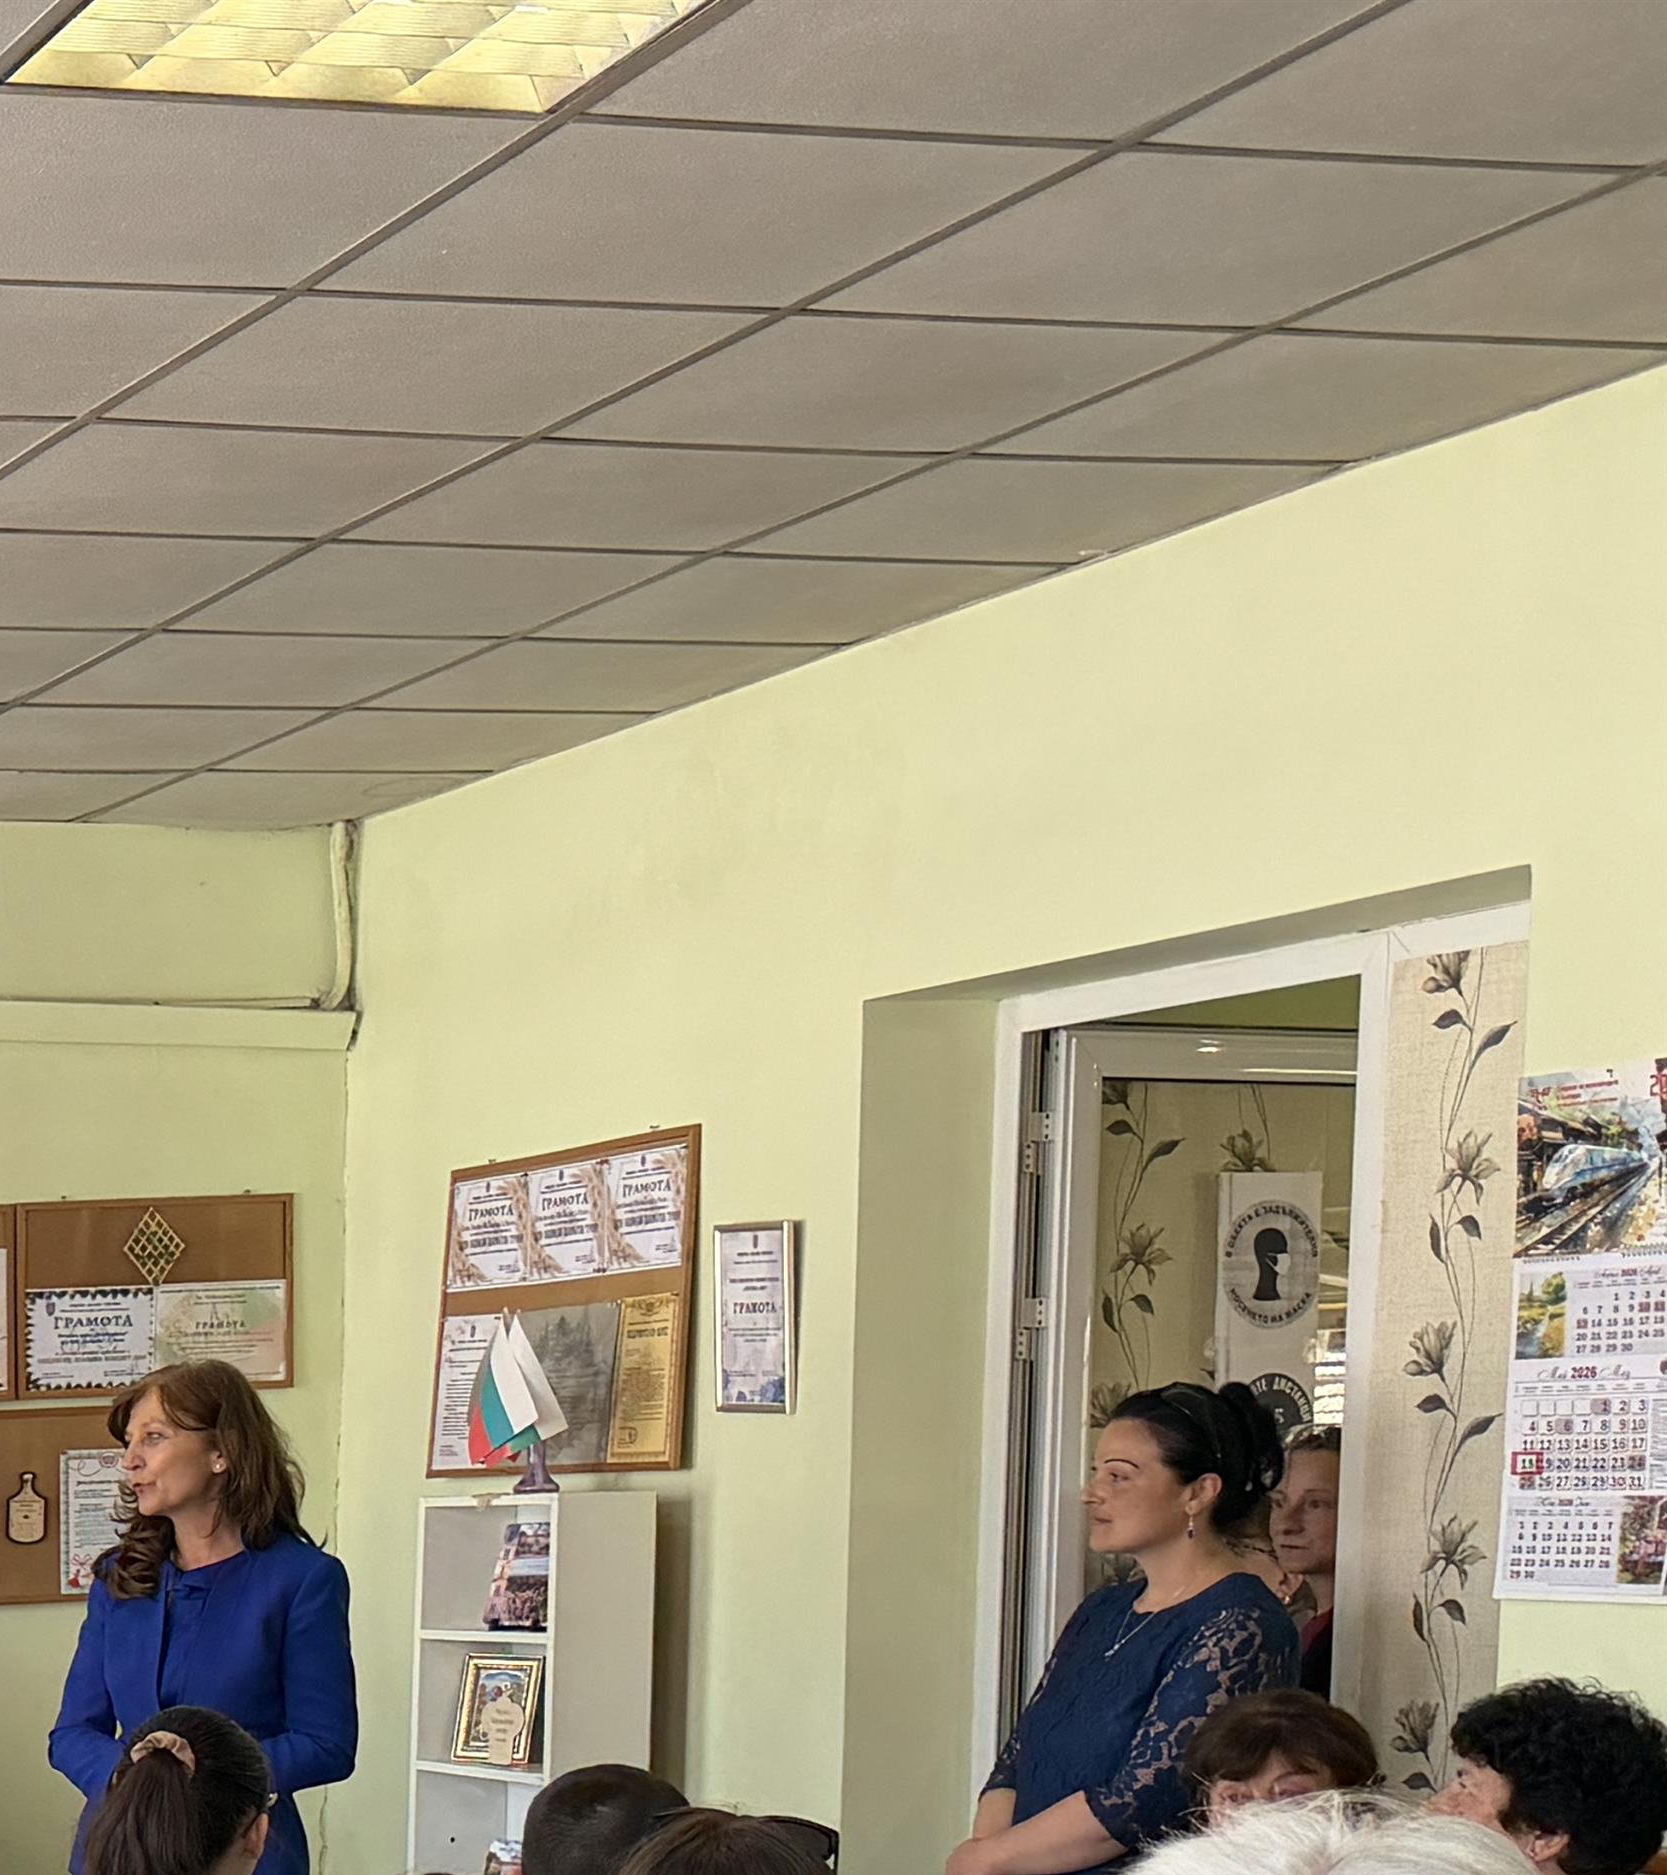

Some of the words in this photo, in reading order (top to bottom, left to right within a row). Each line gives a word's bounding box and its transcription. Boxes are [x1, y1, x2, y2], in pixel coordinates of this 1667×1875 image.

[622, 1178, 671, 1198] ГРАМОТА
[541, 1191, 589, 1211] ГРАМОТА
[468, 1204, 514, 1222] ГРАМОТА
[733, 1301, 778, 1314] ГРАМОТА
[53, 1314, 133, 1330] ГРАМОТА
[1570, 1366, 1597, 1379] 2026
[1619, 1400, 1627, 1412] 2
[1638, 1399, 1646, 1412] 3
[1529, 1421, 1536, 1432] 4
[1546, 1421, 1553, 1432] 5
[1582, 1420, 1589, 1431] 7
[1600, 1420, 1608, 1431] 8
[1619, 1419, 1627, 1431] 9
[1631, 1419, 1646, 1430] 10
[1523, 1440, 1535, 1451] 11
[1539, 1439, 1552, 1450] 12
[1557, 1439, 1571, 1450] 13
[1574, 1439, 1588, 1450] 14
[1593, 1438, 1607, 1450] 15
[1611, 1438, 1626, 1449] 16
[1631, 1437, 1645, 1449] 17
[1555, 1458, 1571, 1470] 20
[1573, 1457, 1587, 1469] 21
[1591, 1457, 1607, 1470] 22
[1611, 1457, 1626, 1469] 23
[1556, 1476, 1569, 1487] 27
[1610, 1476, 1626, 1487] 30
[1629, 1476, 1644, 1487] 31
